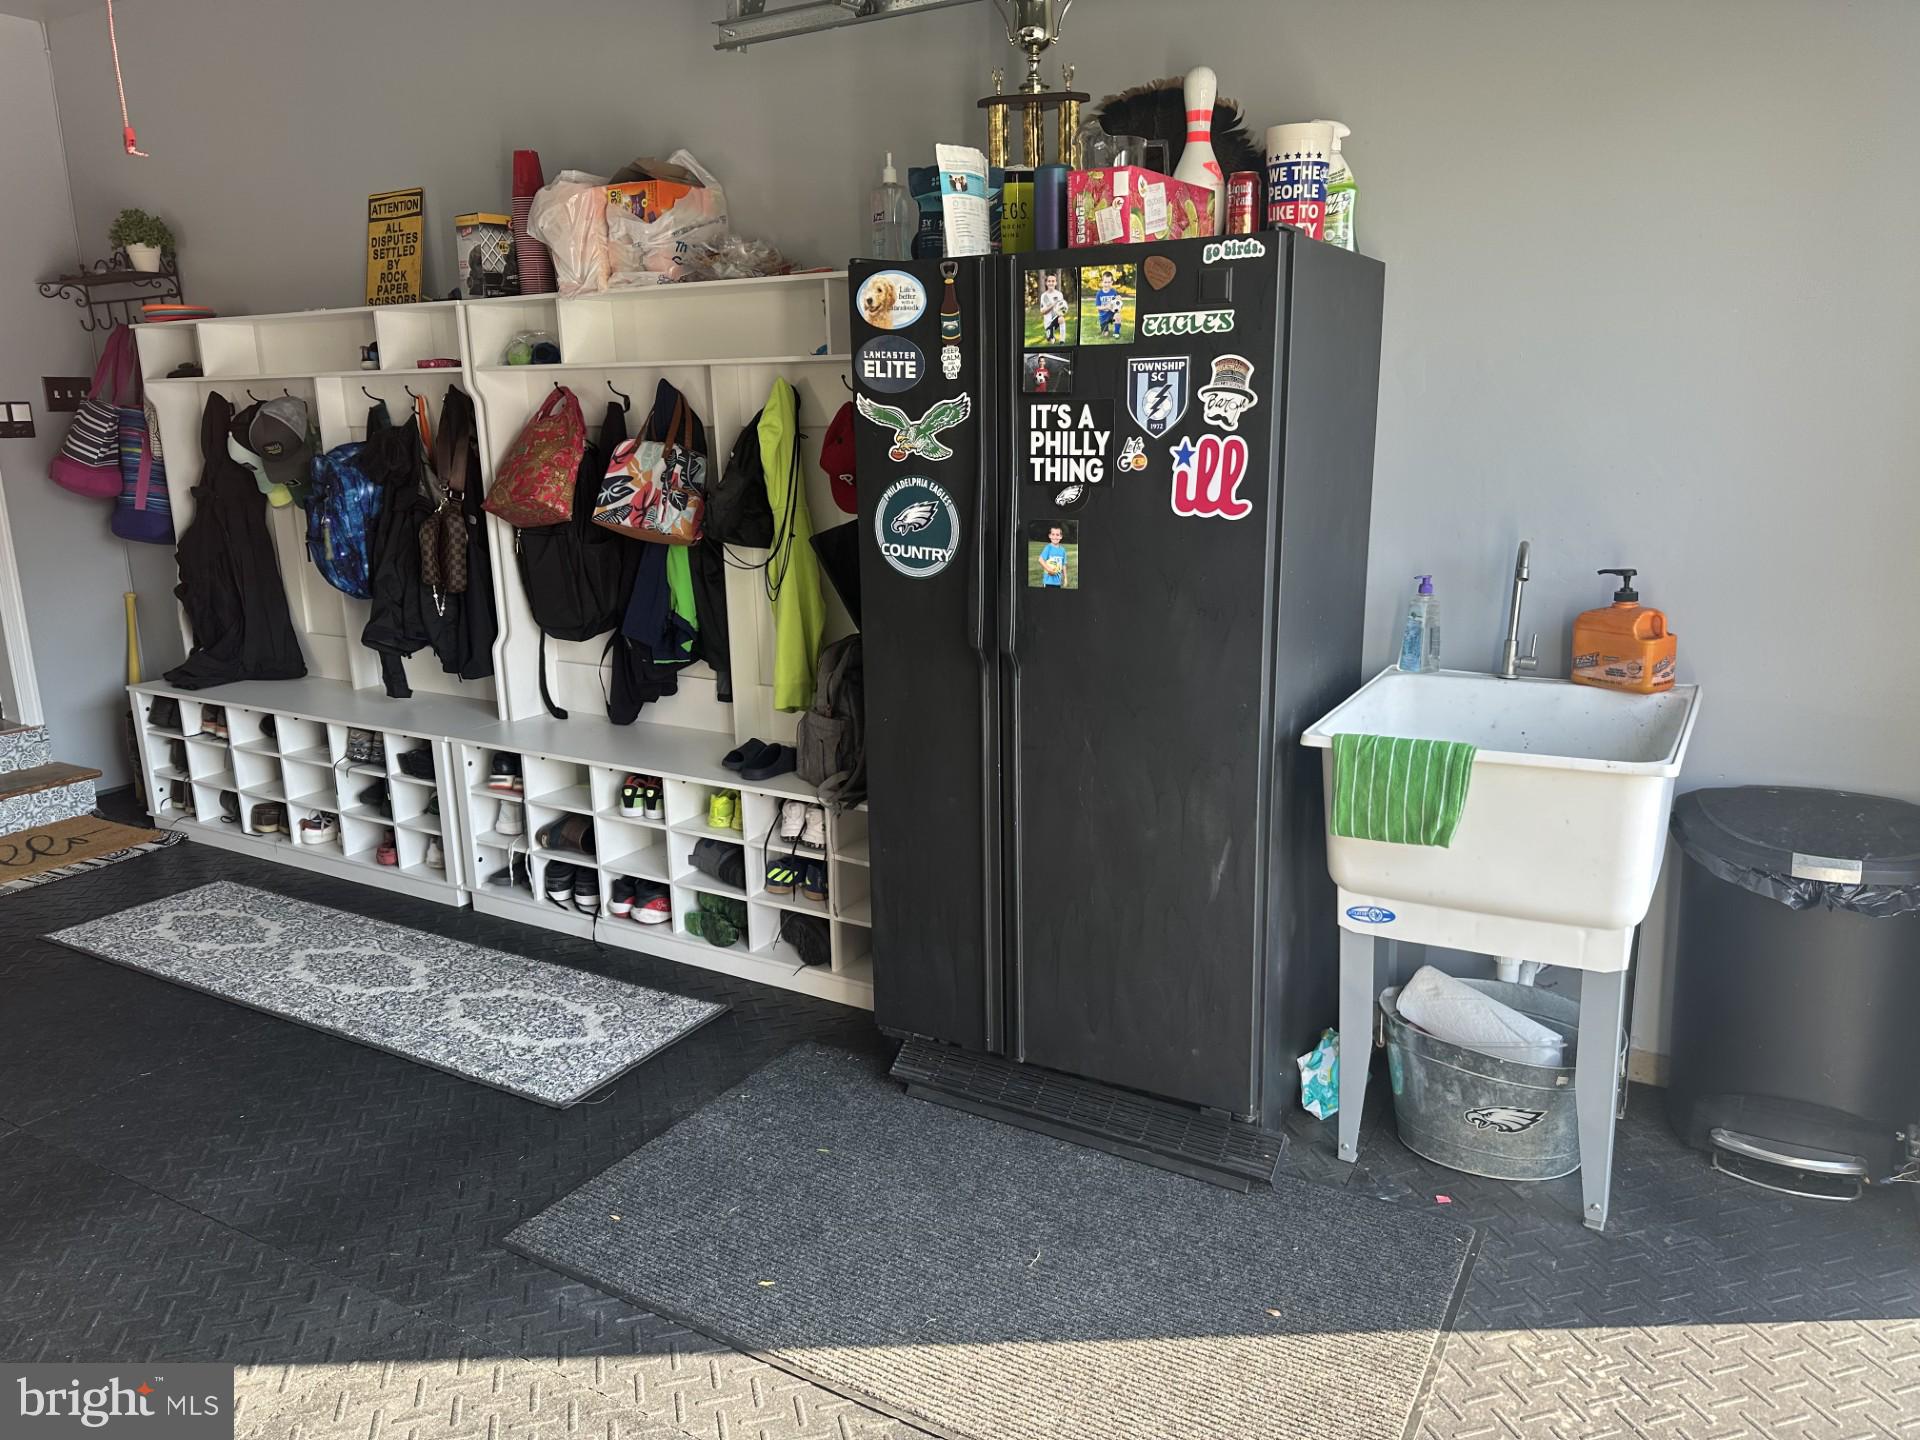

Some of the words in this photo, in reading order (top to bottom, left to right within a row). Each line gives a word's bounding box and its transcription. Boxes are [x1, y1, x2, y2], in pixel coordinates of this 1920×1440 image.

[1269, 166, 1288, 183] WE
[1292, 166, 1321, 180] THE
[1268, 183, 1320, 202] PEOPLE
[371, 198, 419, 216] ATTENTION
[1268, 204, 1295, 224] LIKE
[1299, 204, 1319, 220] TO
[385, 221, 404, 234] ALL
[371, 232, 418, 248] DISPUTES
[372, 245, 416, 260] SETTLED
[1205, 244, 1221, 262] go
[1224, 241, 1263, 256] birds.
[387, 258, 400, 271] BY
[380, 270, 407, 284] ROCK
[377, 283, 409, 296] PAPER
[368, 294, 417, 306] SCISSORS
[1144, 311, 1234, 335] EAGLES
[864, 350, 916, 360] LANCASTER
[864, 360, 917, 379] ELITE
[1131, 361, 1186, 372] TOWNSHIP
[1151, 372, 1166, 382] SC
[1030, 403, 1072, 429] IT'S
[1078, 403, 1095, 429] A
[1030, 431, 1111, 456] PHILLY
[1030, 458, 1104, 483] THING
[883, 477, 928, 502] PHILADELPHIA
[928, 482, 953, 506] EAGLES
[881, 543, 953, 562] COUNTRY
